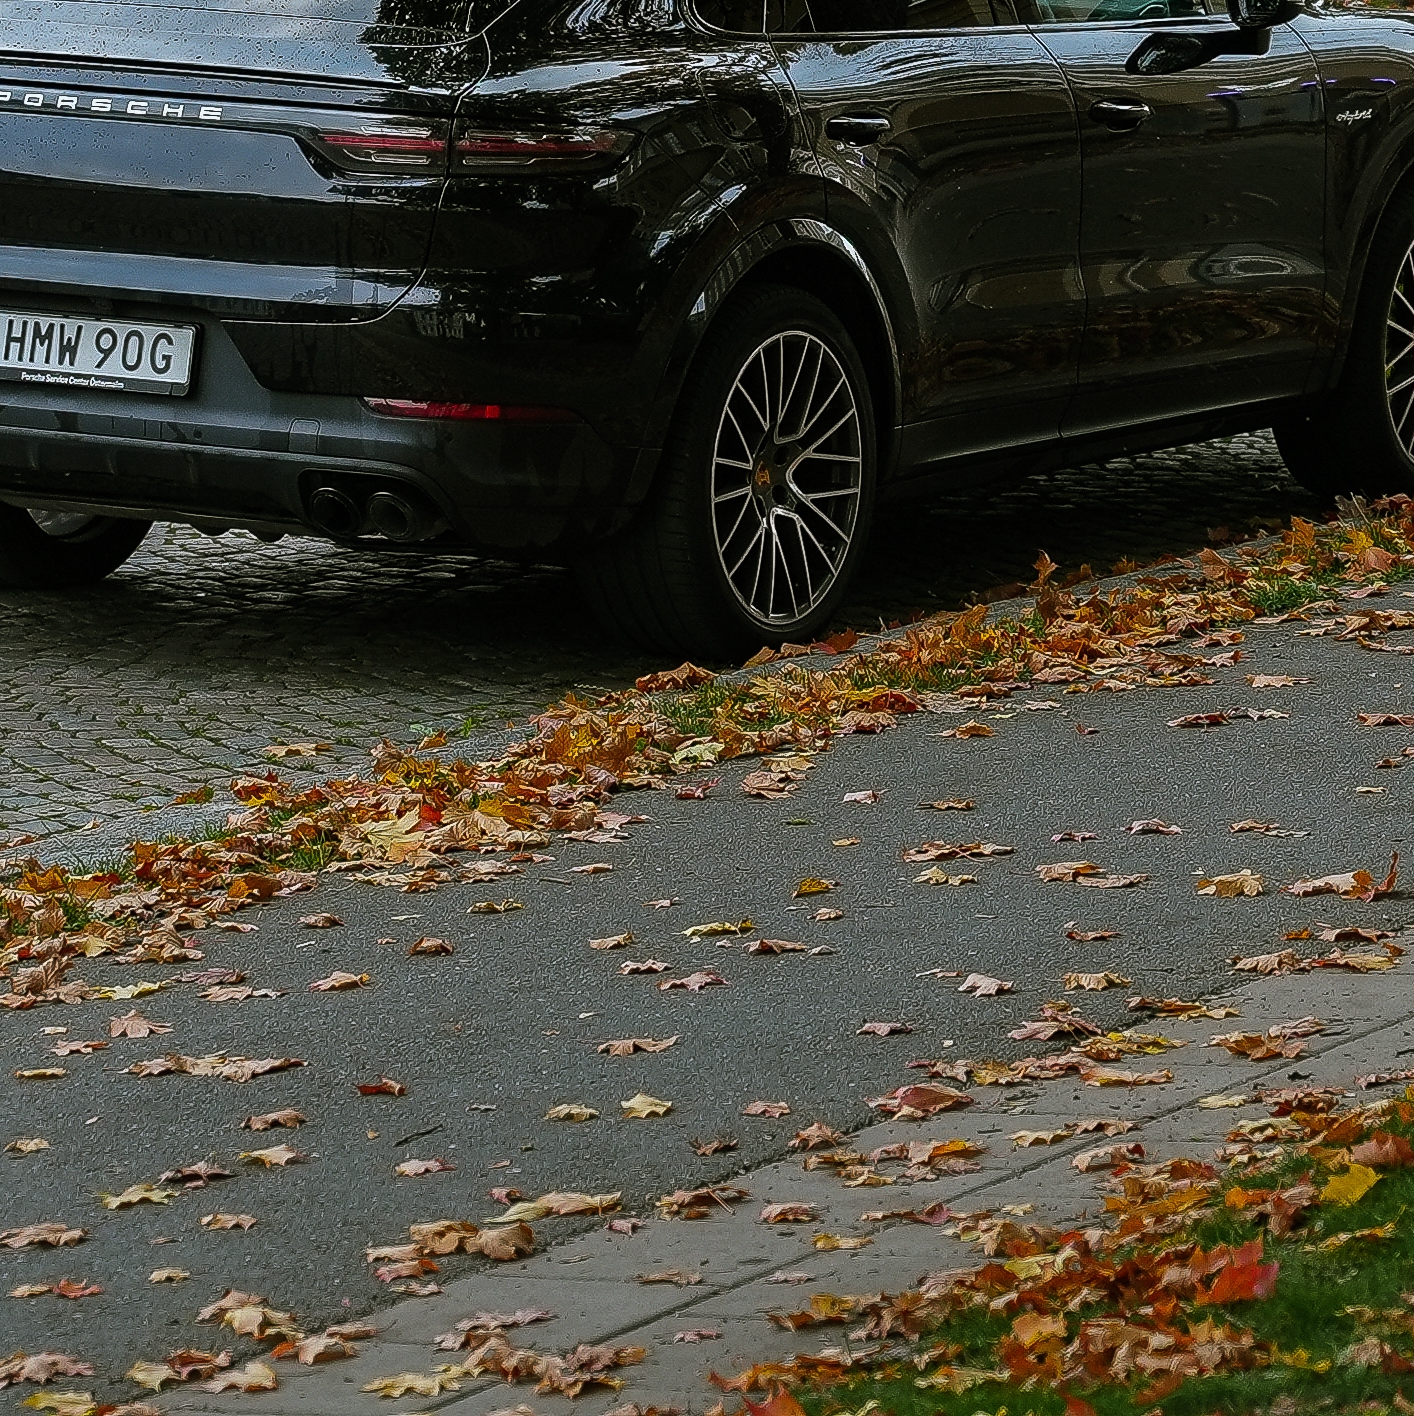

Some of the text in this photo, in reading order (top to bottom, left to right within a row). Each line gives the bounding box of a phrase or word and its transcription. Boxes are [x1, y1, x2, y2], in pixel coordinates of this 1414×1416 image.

[3, 318, 175, 374] HMW 90G
[21, 371, 46, 382] Porsche
